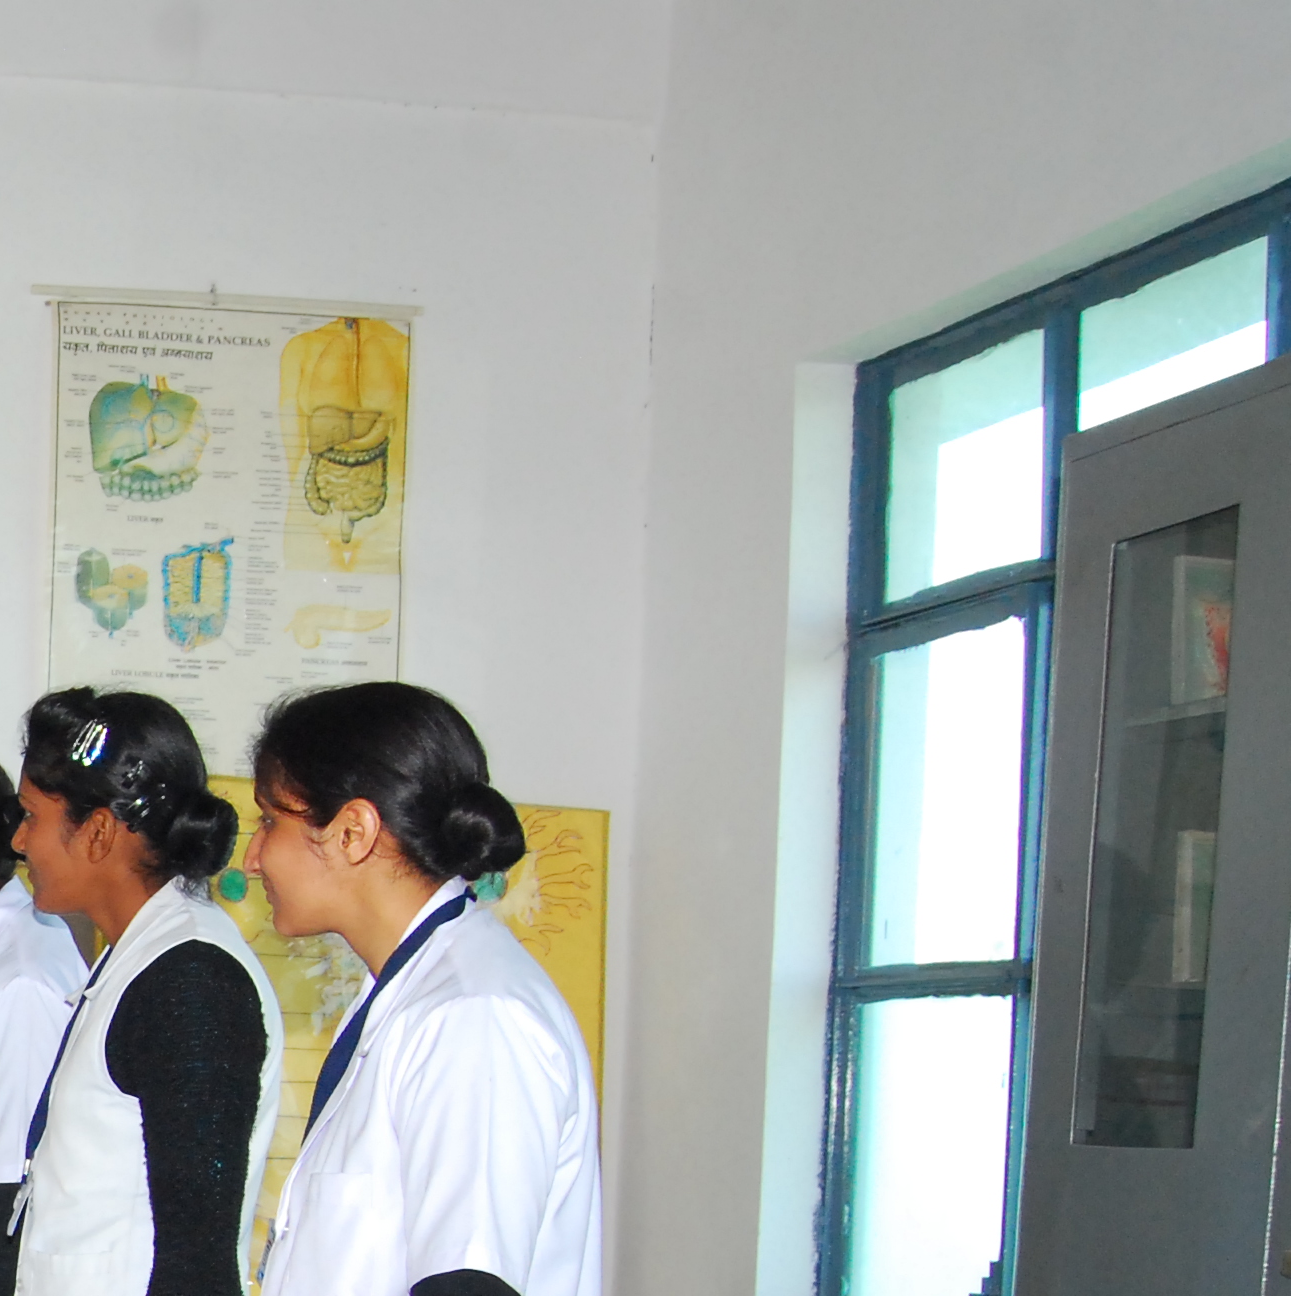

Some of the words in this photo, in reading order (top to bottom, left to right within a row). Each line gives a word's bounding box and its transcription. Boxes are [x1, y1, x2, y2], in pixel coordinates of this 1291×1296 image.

[63, 325, 100, 338] LIVER,
[103, 328, 133, 339] GALL
[138, 330, 193, 343] BLADDER
[196, 336, 204, 344] &
[207, 335, 271, 347] PANCREAS
